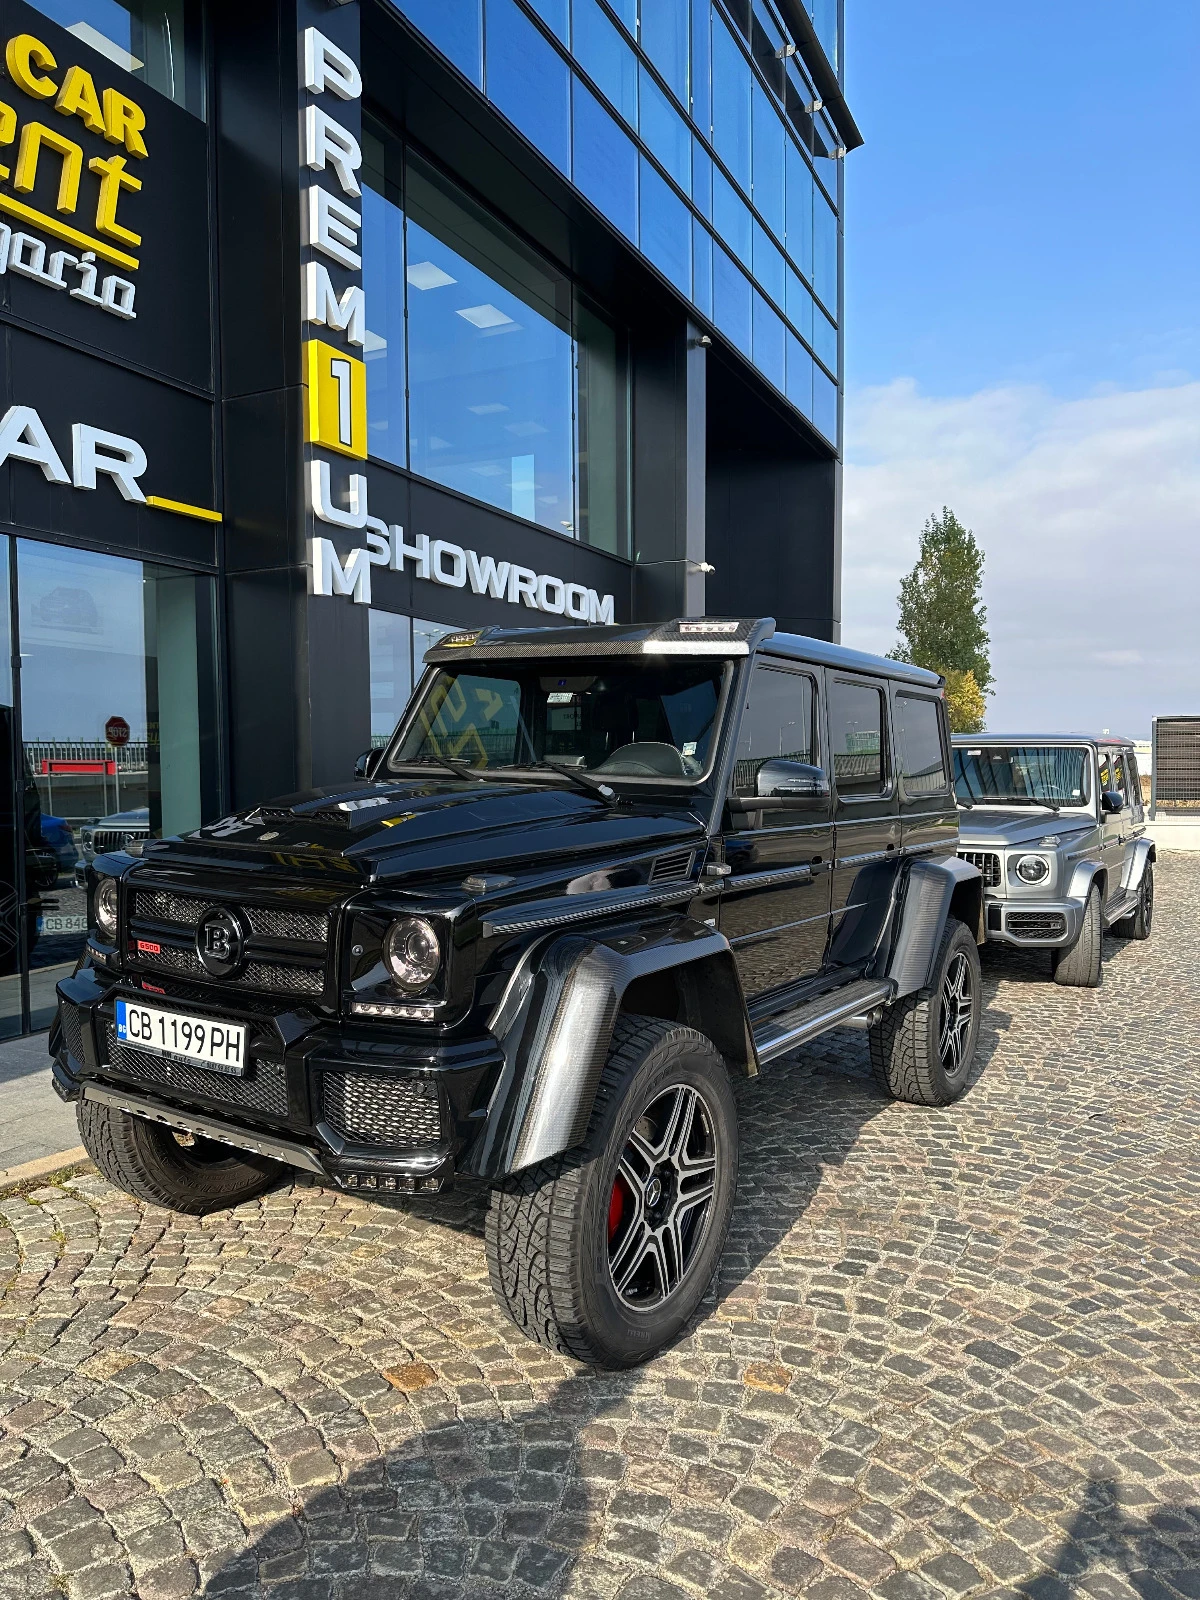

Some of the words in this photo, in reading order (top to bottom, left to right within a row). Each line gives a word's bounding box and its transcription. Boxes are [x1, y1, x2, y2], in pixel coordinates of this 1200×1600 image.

[6, 33, 149, 158] CAR
[0, 222, 137, 320] aria
[366, 515, 614, 626] SHOWROOM
[118, 1023, 127, 1034] BG
[129, 1009, 152, 1040] CB
[159, 1016, 205, 1053] 1199
[210, 1026, 241, 1062] PH
